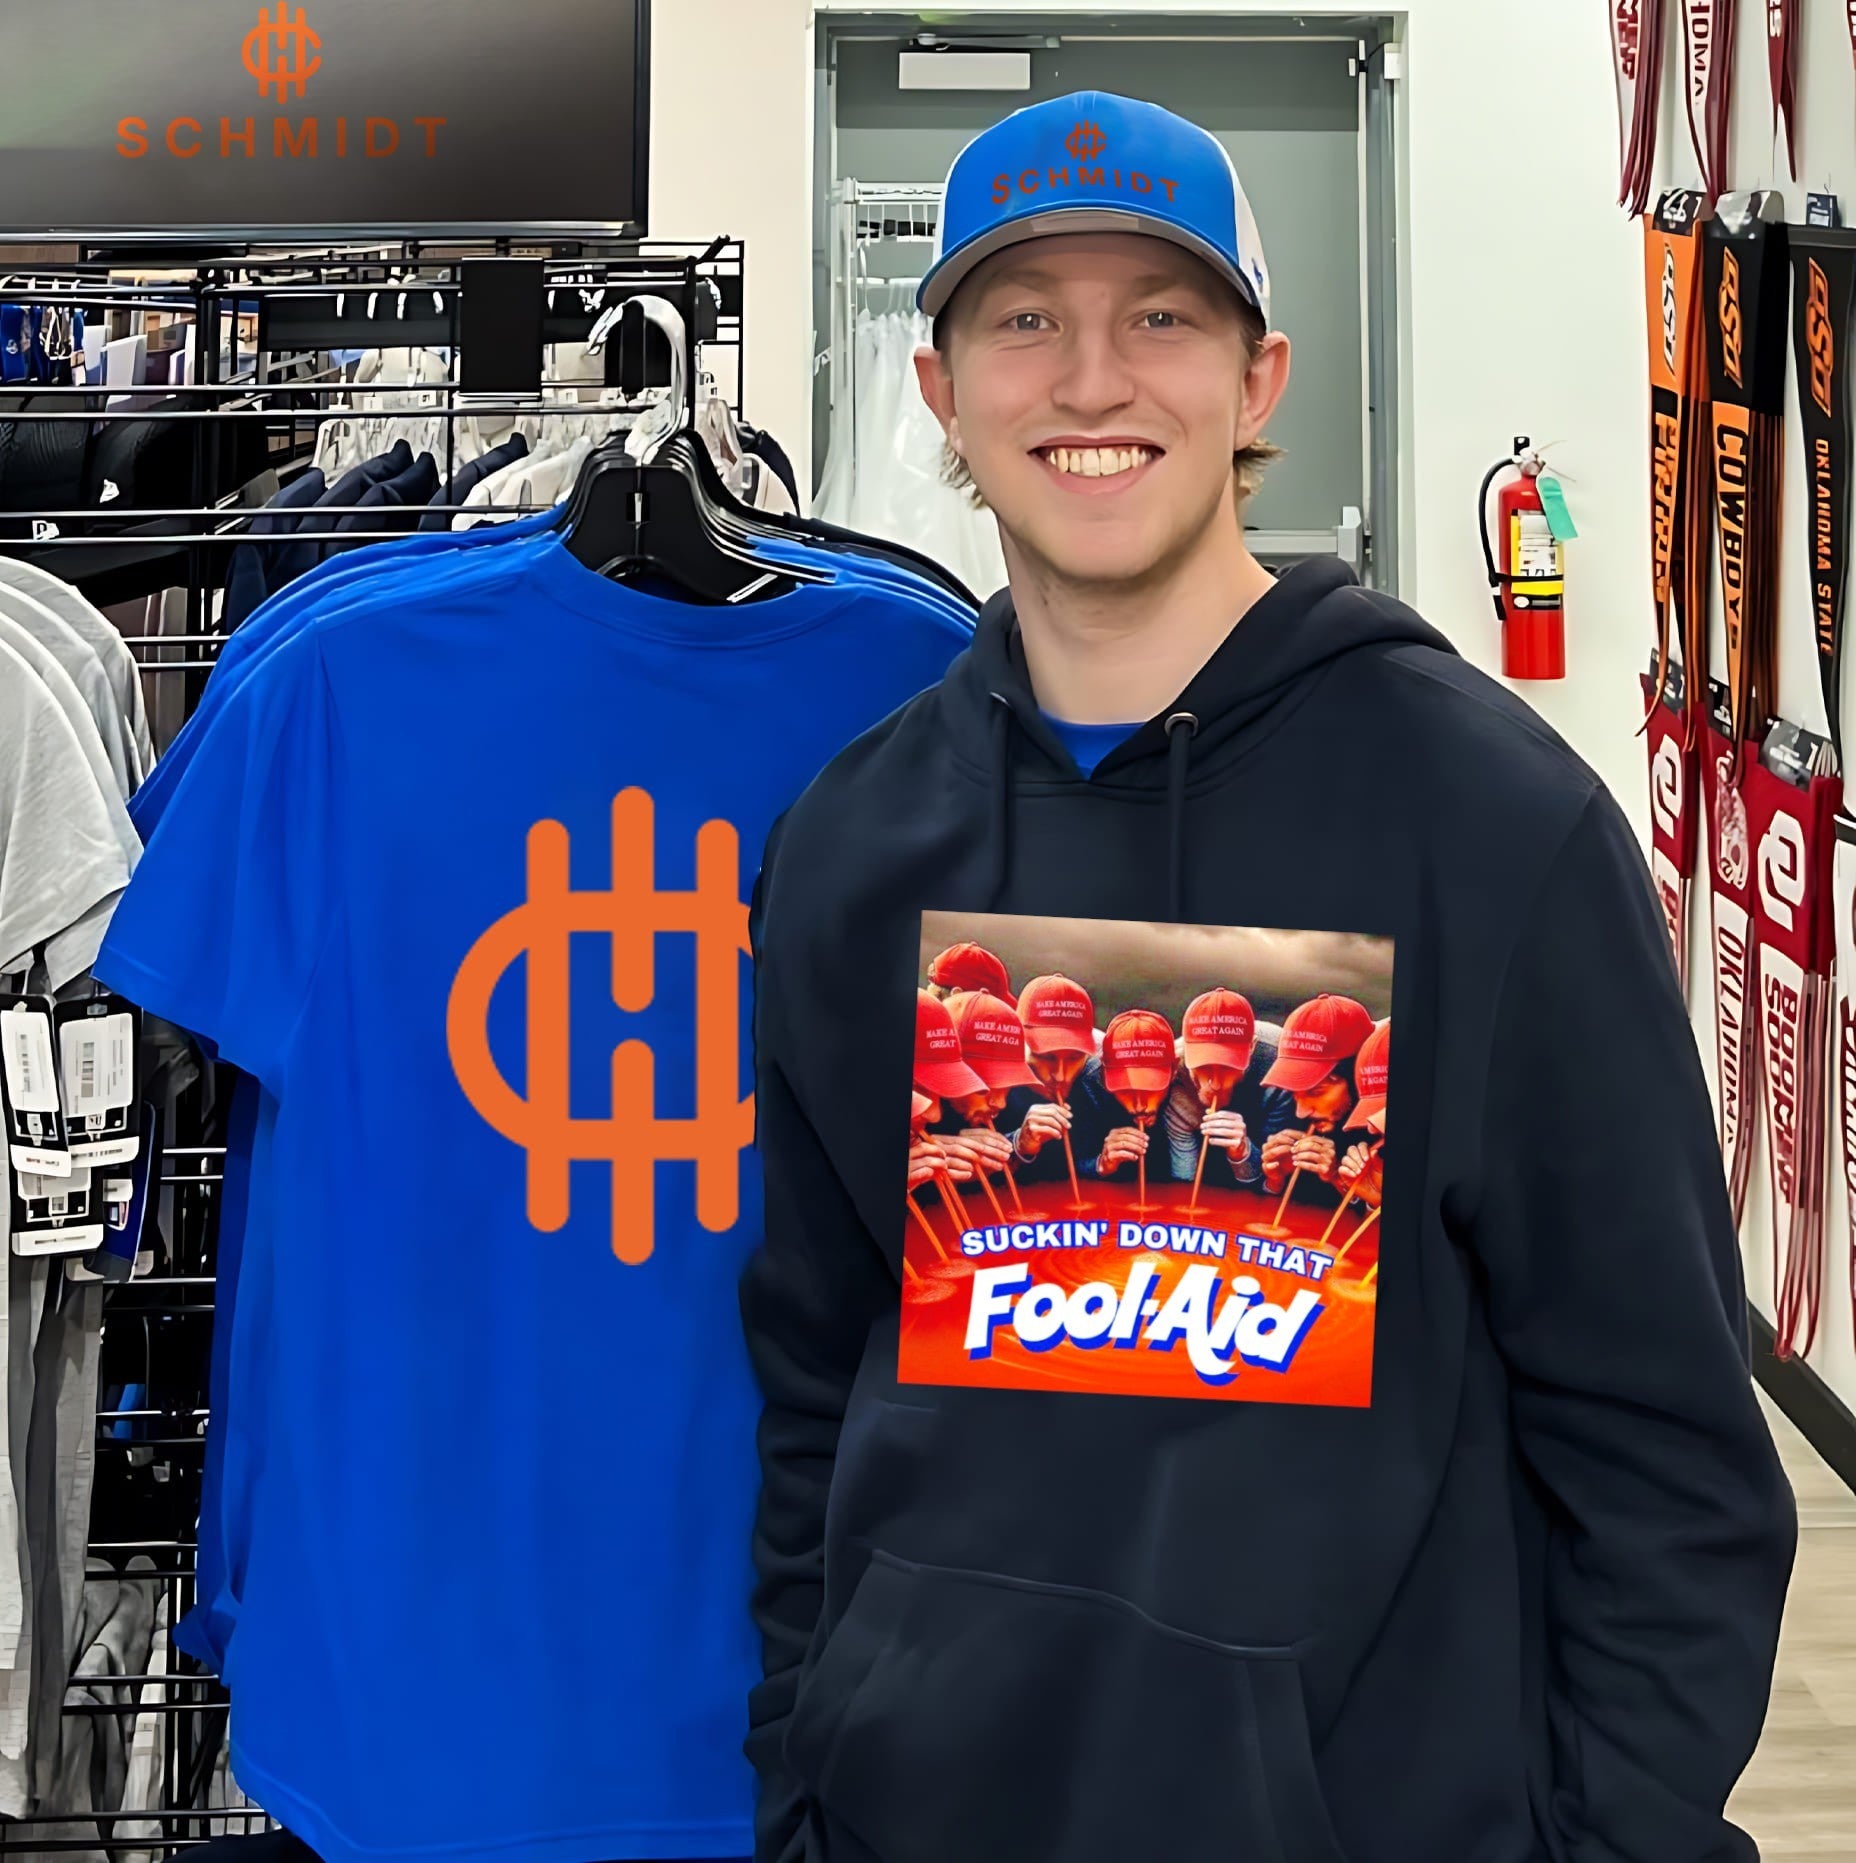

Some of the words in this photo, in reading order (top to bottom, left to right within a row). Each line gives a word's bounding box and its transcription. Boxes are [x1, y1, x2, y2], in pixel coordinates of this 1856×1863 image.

[116, 117, 447, 159] SCHMIDT
[991, 166, 1180, 205] SCHMIDT
[1805, 257, 1834, 418] OSU
[1815, 438, 1832, 571] OKLAHOMA
[1055, 1000, 1087, 1011] AMERICA
[1038, 1009, 1061, 1018] GREAT
[1062, 1010, 1084, 1019] AGAIN
[974, 1021, 997, 1031] MAKE
[1211, 1015, 1248, 1026] AMERICA
[926, 1028, 948, 1039] MAKE
[1192, 1026, 1218, 1036] GREAT
[1218, 1027, 1245, 1036] AGAIN
[1293, 1030, 1328, 1043] AMERICA
[975, 1032, 1001, 1043] GREAT
[929, 1039, 956, 1049] GREAT
[1132, 1040, 1167, 1049] AMERICA
[1299, 1042, 1324, 1052] AGAIN
[1115, 1050, 1139, 1059] GREAT
[1140, 1050, 1164, 1058] AGAIN
[962, 1221, 1108, 1256] SUCKIN'
[1118, 1223, 1227, 1257] DOWN
[1236, 1235, 1334, 1281] THAT
[964, 1261, 1325, 1385] Fool-Aid
